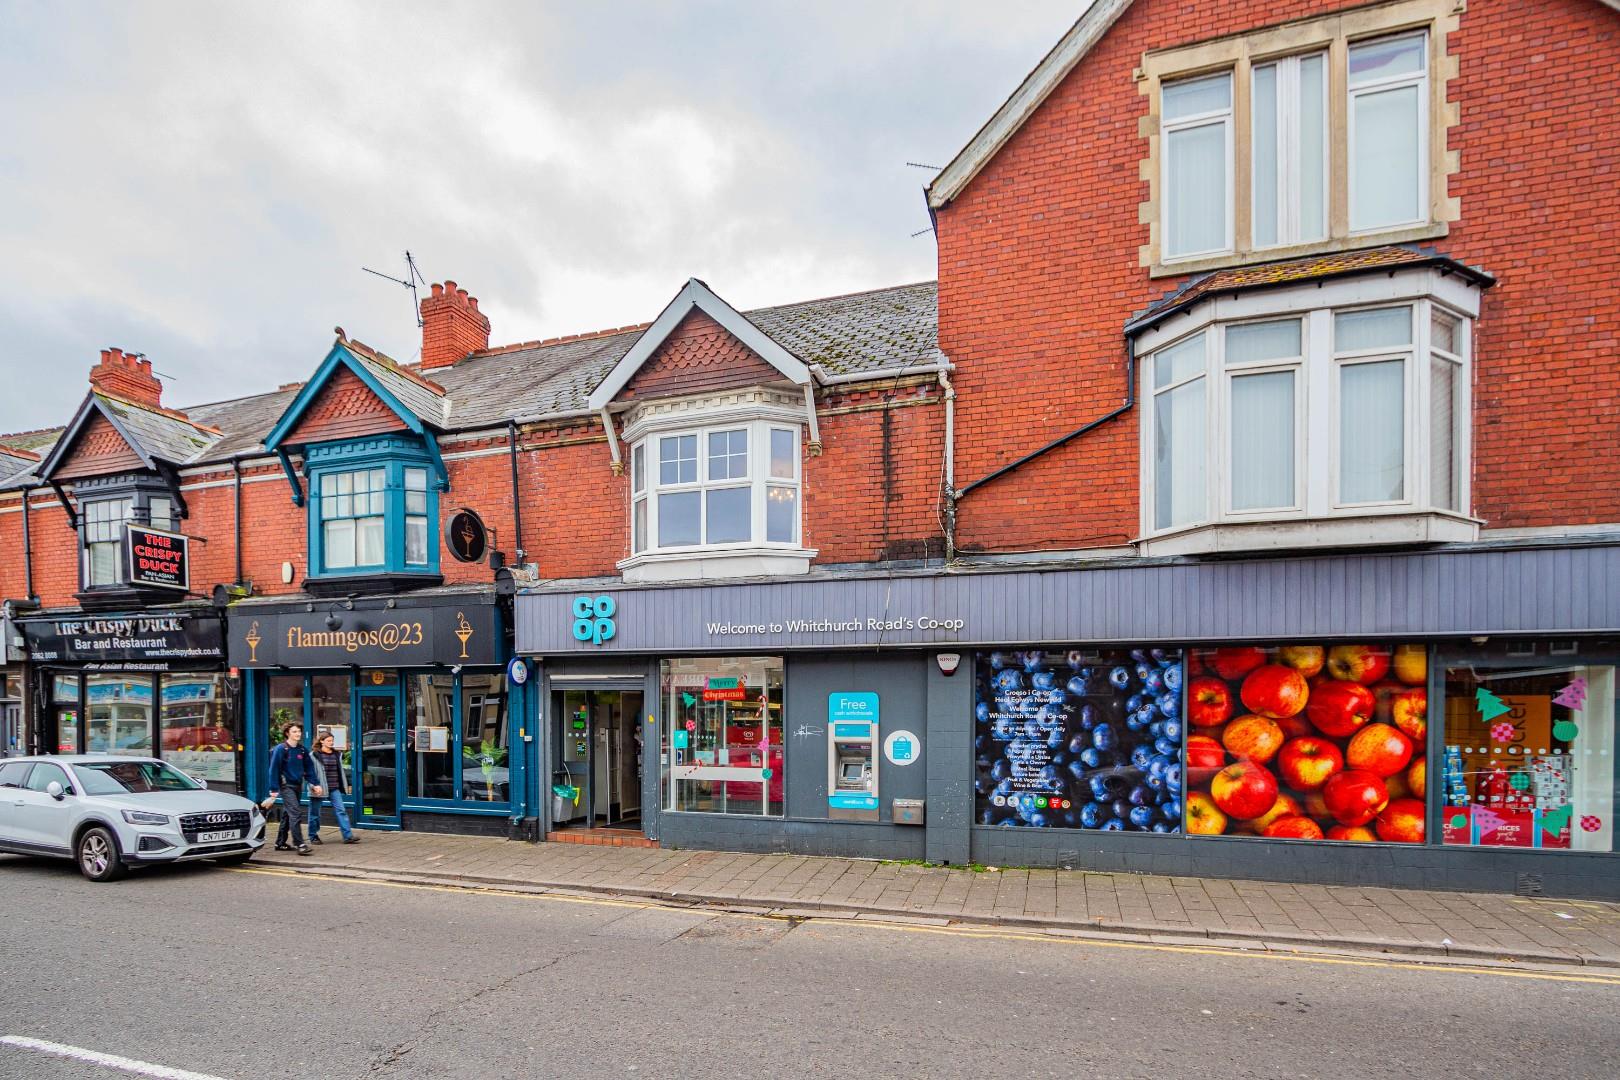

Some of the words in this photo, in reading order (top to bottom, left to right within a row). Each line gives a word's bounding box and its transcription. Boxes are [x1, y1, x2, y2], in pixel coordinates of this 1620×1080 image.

[144, 534, 171, 548] THE
[134, 545, 182, 562] CRISPY
[139, 558, 179, 574] DUCK
[707, 622, 766, 635] Welcome
[769, 623, 783, 634] to
[786, 618, 863, 633] Whitchurch
[867, 617, 914, 631] Road's
[917, 616, 964, 632] Co-op
[74, 638, 91, 650] Bar
[93, 638, 111, 649] and
[113, 636, 167, 649] Restaurant
[287, 622, 423, 652] flamingos@23
[144, 647, 221, 657] www.thecrispyduck.co.uk
[123, 662, 169, 670] Restaurant
[704, 690, 744, 699] Christmas
[840, 698, 867, 710] Free
[1047, 712, 1068, 720] Co-op
[202, 832, 220, 841] CN71
[221, 831, 236, 839] UFA
